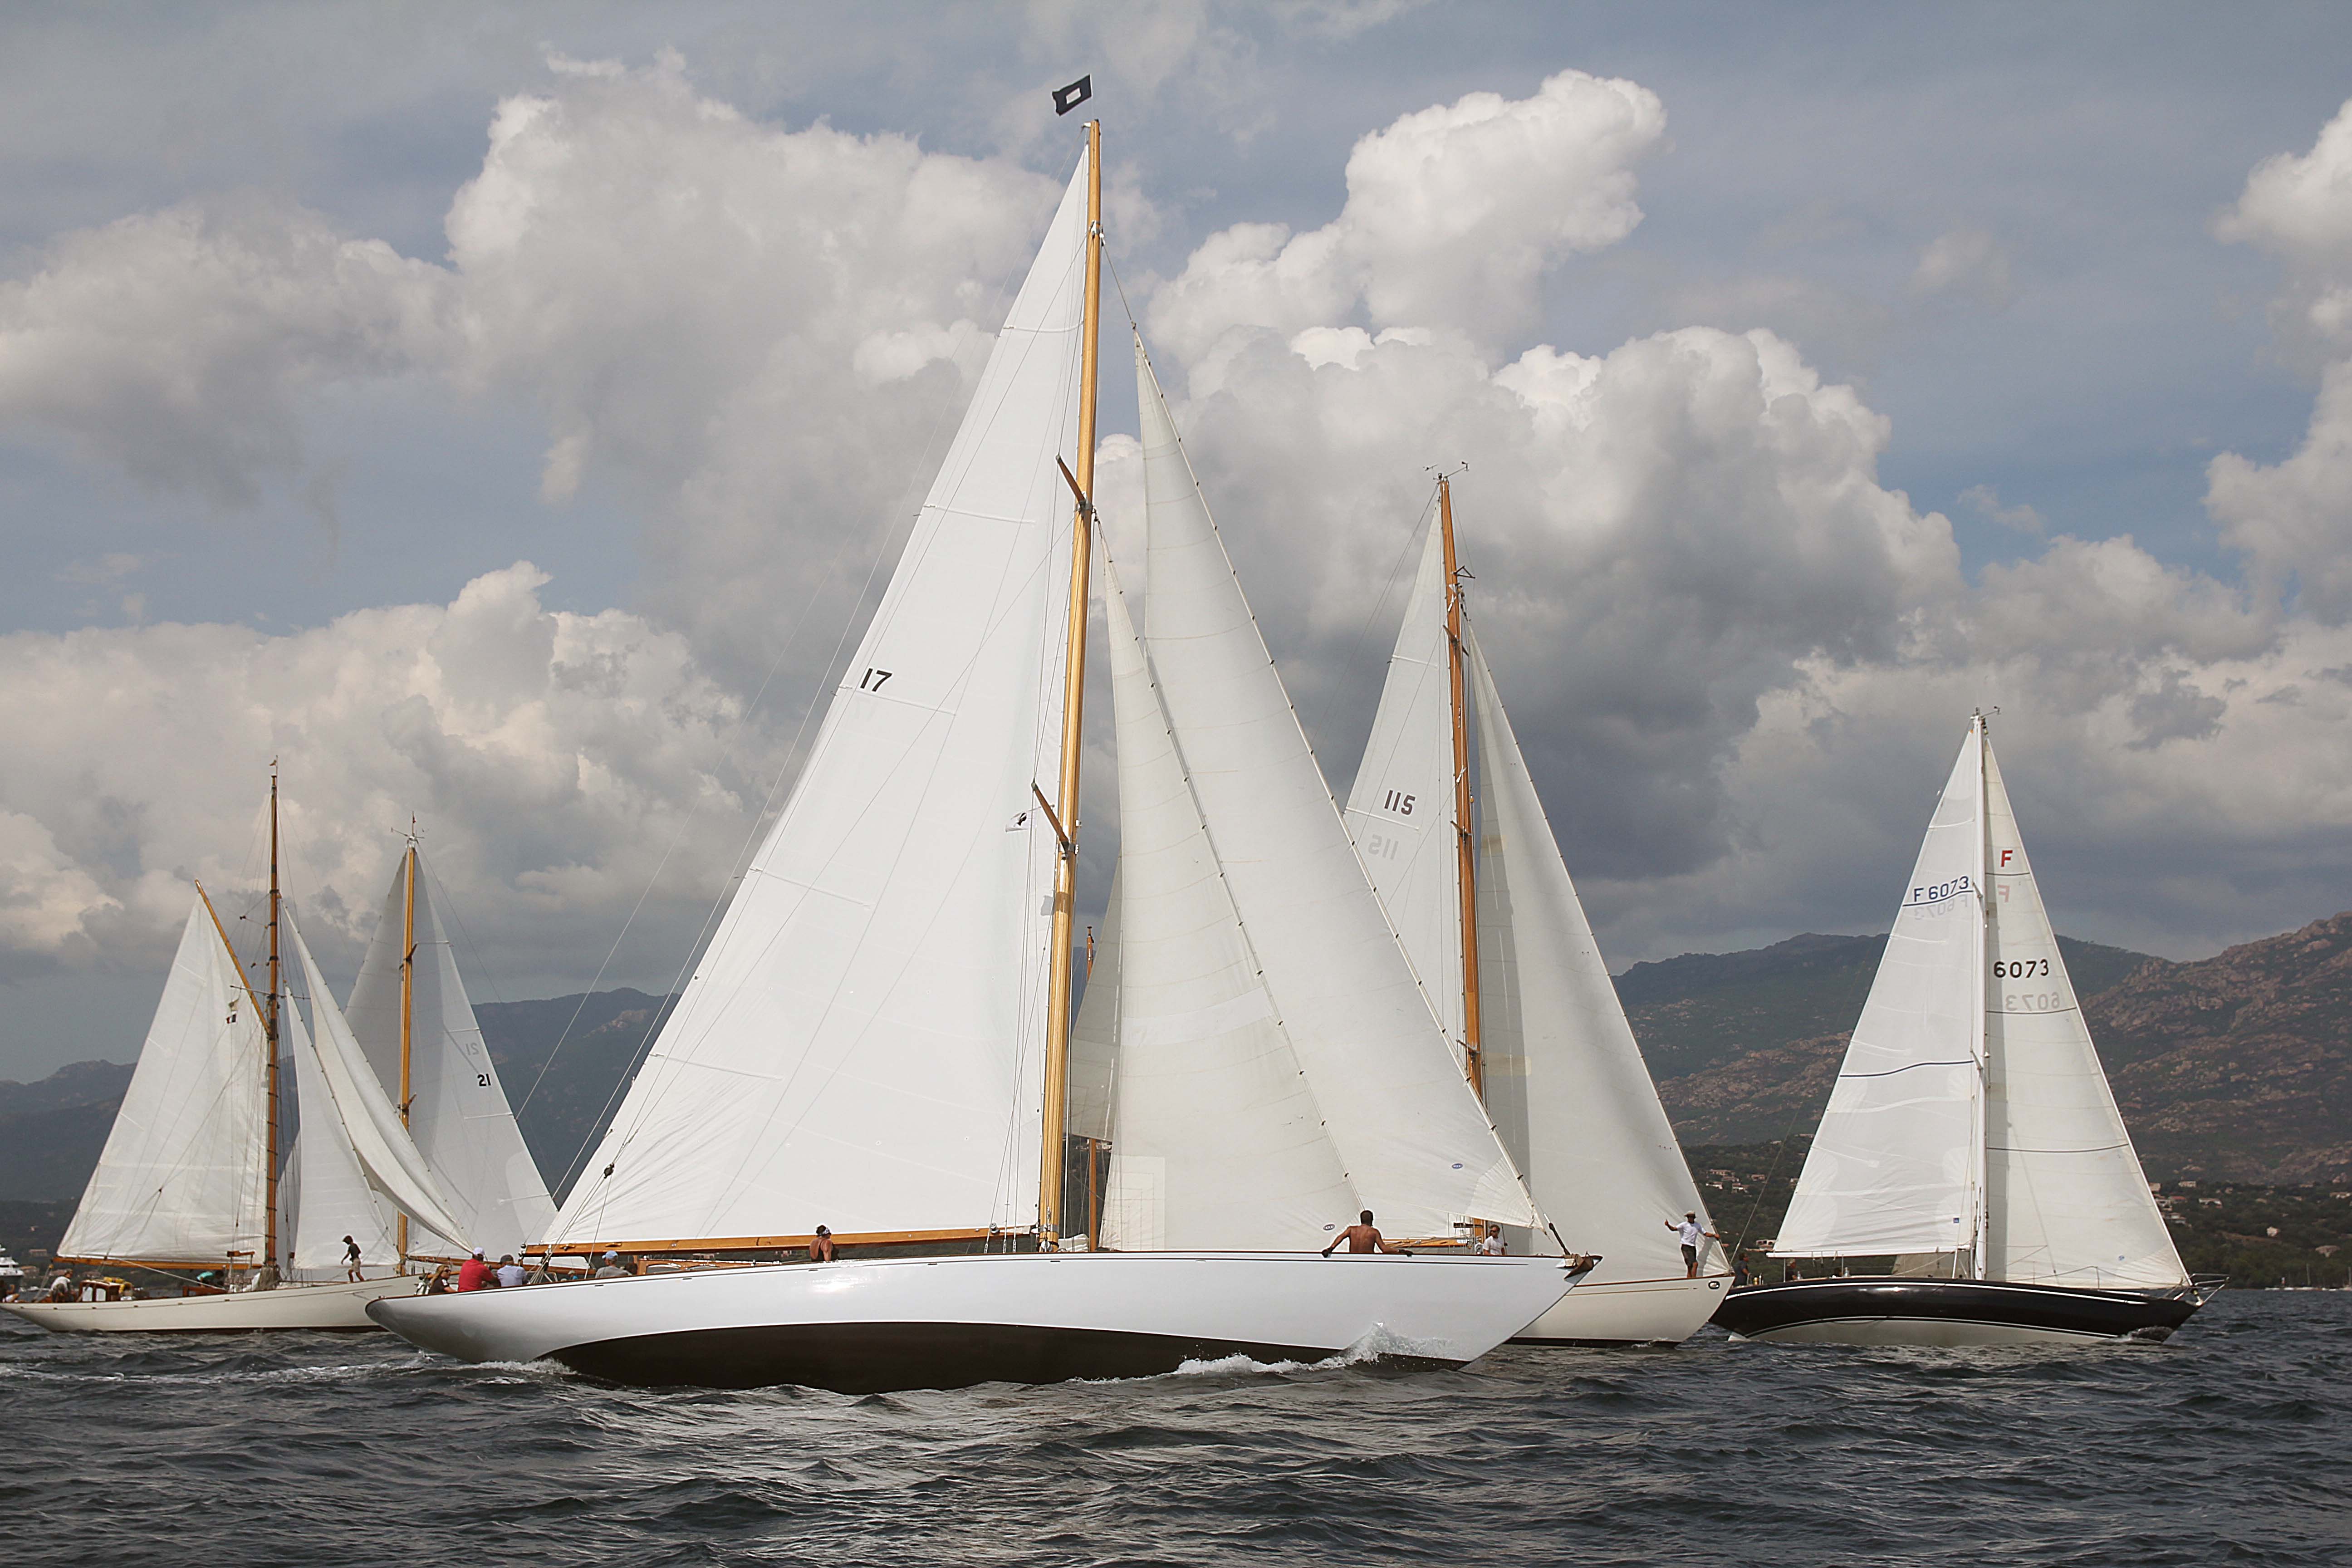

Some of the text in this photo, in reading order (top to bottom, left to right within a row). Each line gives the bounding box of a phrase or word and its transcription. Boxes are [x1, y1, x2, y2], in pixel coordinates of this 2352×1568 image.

[860, 668, 892, 692] 17
[1384, 789, 1416, 815] 115
[2001, 850, 2013, 867] F
[1914, 876, 1968, 902] F 6073
[1994, 959, 2048, 978] 6073
[477, 1073, 491, 1086] 21
